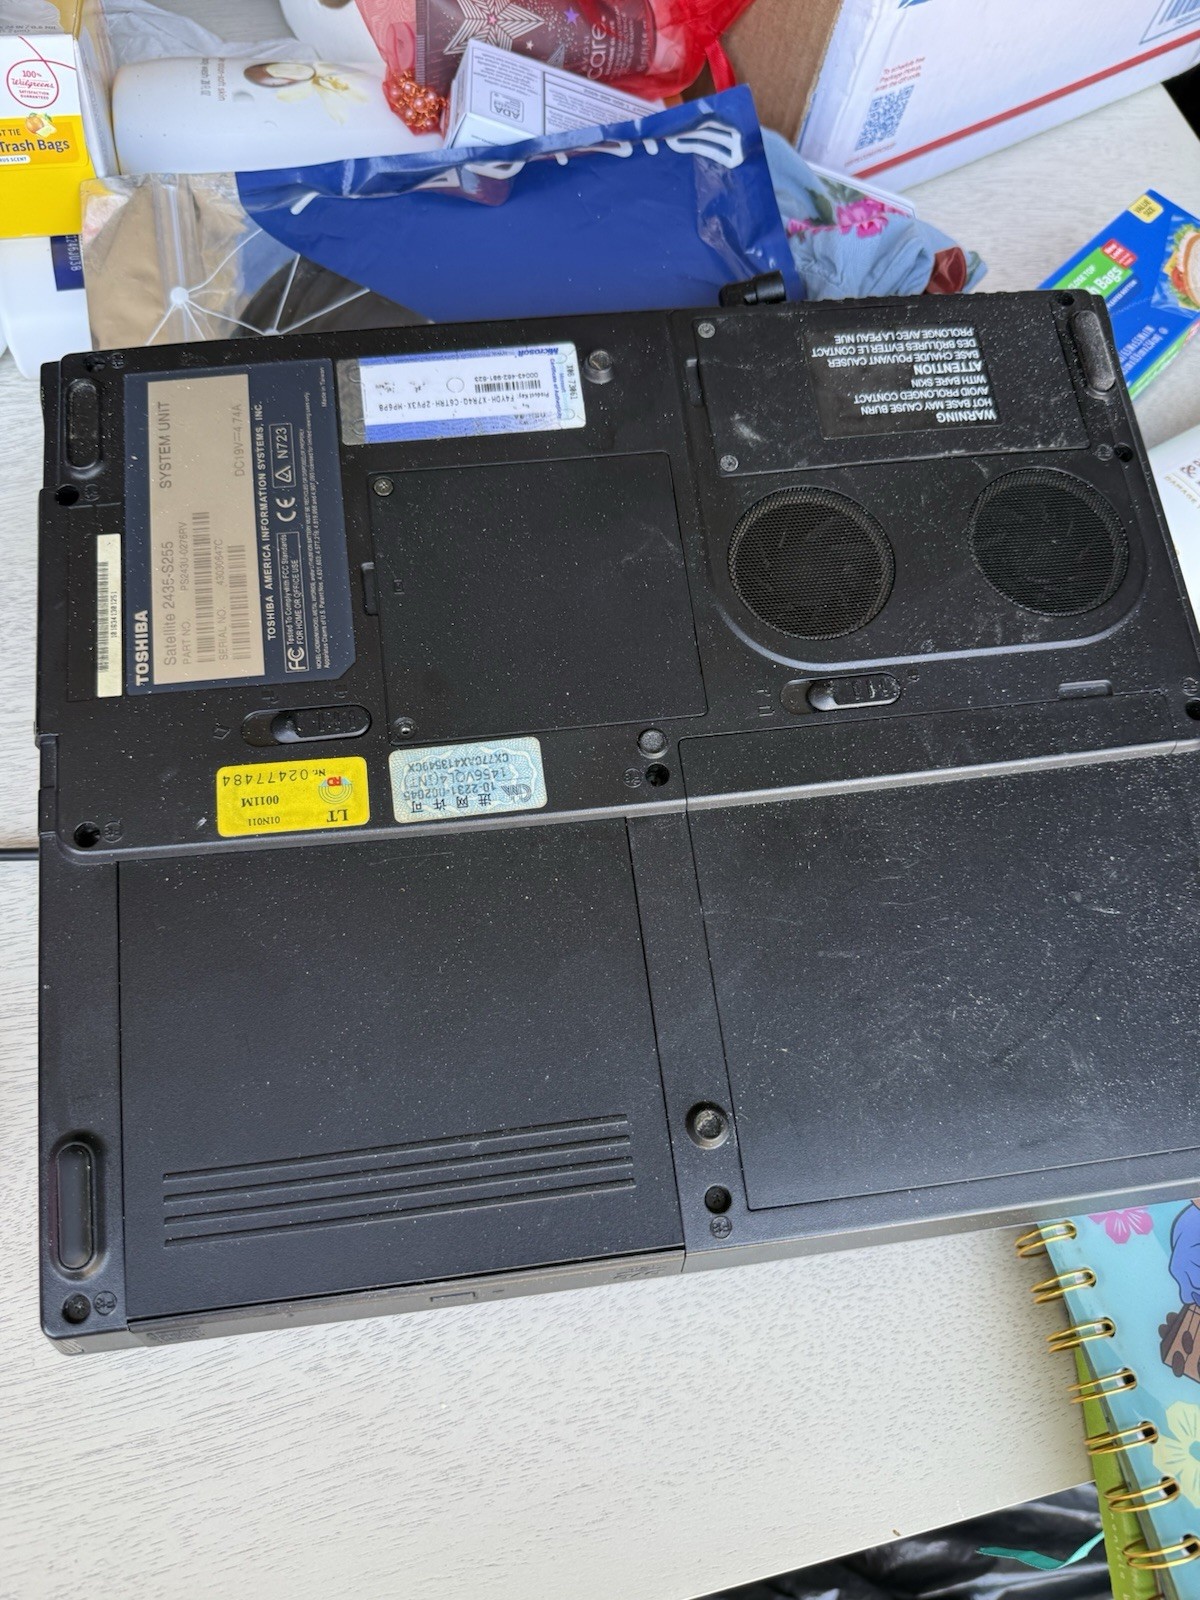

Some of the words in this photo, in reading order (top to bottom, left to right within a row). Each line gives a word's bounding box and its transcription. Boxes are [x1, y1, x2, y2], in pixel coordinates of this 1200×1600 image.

[493, 107, 521, 121] ADA
[7, 128, 21, 136] TIE
[37, 139, 70, 153] Bags
[1093, 266, 1123, 290] Bags
[834, 334, 856, 345] NUE
[856, 333, 882, 343] PEAU
[882, 332, 894, 341] LA
[896, 330, 920, 340] AVEC
[920, 327, 974, 339] PROLONGE
[857, 345, 870, 354] LE
[870, 343, 904, 354] EVITER
[956, 338, 977, 348] DES
[518, 348, 559, 357] Microsoft
[811, 346, 856, 358] CONTACT
[913, 352, 954, 363] CHAUDE
[953, 350, 980, 360] BASE
[827, 357, 868, 368] CAUSER
[868, 354, 913, 366] POUVANT
[913, 360, 982, 376] ATTENTION
[911, 378, 934, 388] SKIN
[934, 376, 960, 387] BARE
[961, 374, 988, 385] WITH
[853, 392, 899, 404] CONTACT
[900, 388, 960, 401] PROLONGED
[960, 386, 990, 397] AVOID
[320, 392, 328, 408] Made
[924, 400, 944, 411] MAY
[945, 399, 972, 410] BASE
[972, 398, 992, 408] HOT
[254, 401, 263, 421] INC.
[860, 404, 889, 416] BURN
[890, 402, 923, 414] CAUSE
[158, 401, 170, 431] UNIT
[935, 409, 997, 424] WARNING
[276, 427, 288, 459] N723
[158, 435, 172, 489] SYSTEM
[257, 473, 270, 541] INFORMATION
[280, 534, 288, 564] Standards
[262, 544, 274, 590] AMERICA
[282, 565, 290, 579] FCC
[291, 560, 299, 573] USE
[160, 541, 176, 610] 2435-S255
[292, 574, 301, 598] OFFICE
[284, 594, 293, 616] Comply
[294, 598, 301, 610] OR
[266, 595, 276, 640] TOSHIBA
[294, 610, 302, 630] HOME
[162, 613, 178, 666] Satellite
[286, 624, 294, 646] Tested
[296, 630, 304, 645] FOR
[134, 610, 149, 686] TOSHIBA
[218, 627, 228, 660] SERIAL
[181, 639, 192, 665] PART
[222, 769, 308, 786] 02477484
[312, 768, 326, 777] Nr.
[241, 795, 280, 808] 0011M
[411, 794, 492, 814] 进网许可
[248, 816, 281, 826] 01N011
[326, 808, 348, 822] LT
